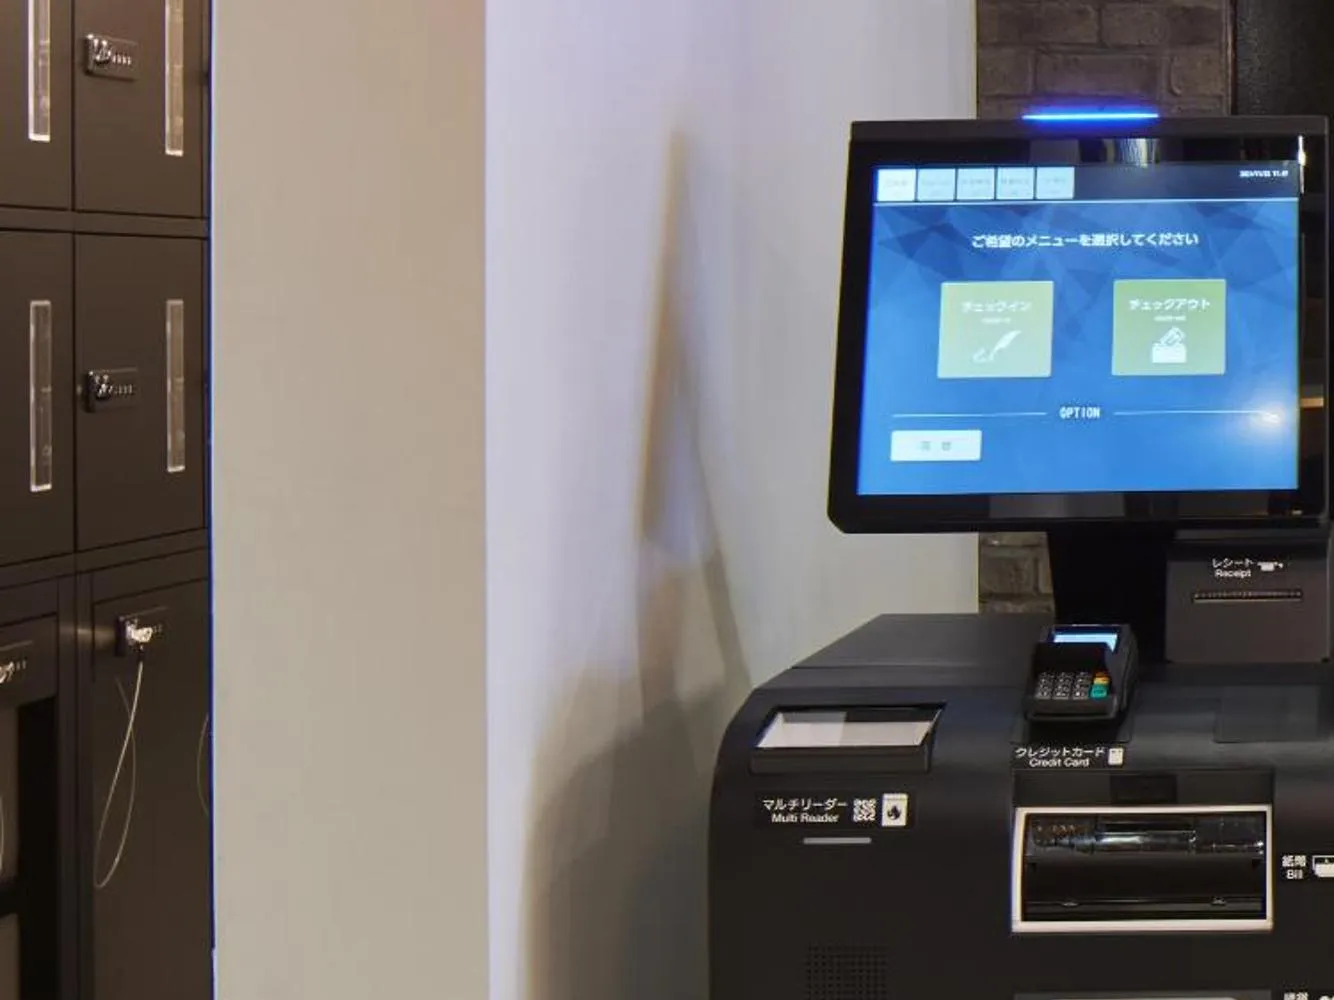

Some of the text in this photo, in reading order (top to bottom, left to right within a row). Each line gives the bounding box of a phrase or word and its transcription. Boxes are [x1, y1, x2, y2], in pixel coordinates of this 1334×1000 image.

[1059, 406, 1101, 420] OPTION
[1212, 558, 1254, 569] レシート
[1215, 569, 1251, 579] Receipt
[1015, 746, 1105, 758] クレジットカード
[1029, 757, 1090, 767] Credit Card
[762, 798, 847, 811] マルチリーダー
[771, 813, 839, 823] Multi Reader
[1286, 869, 1303, 880] Bill
